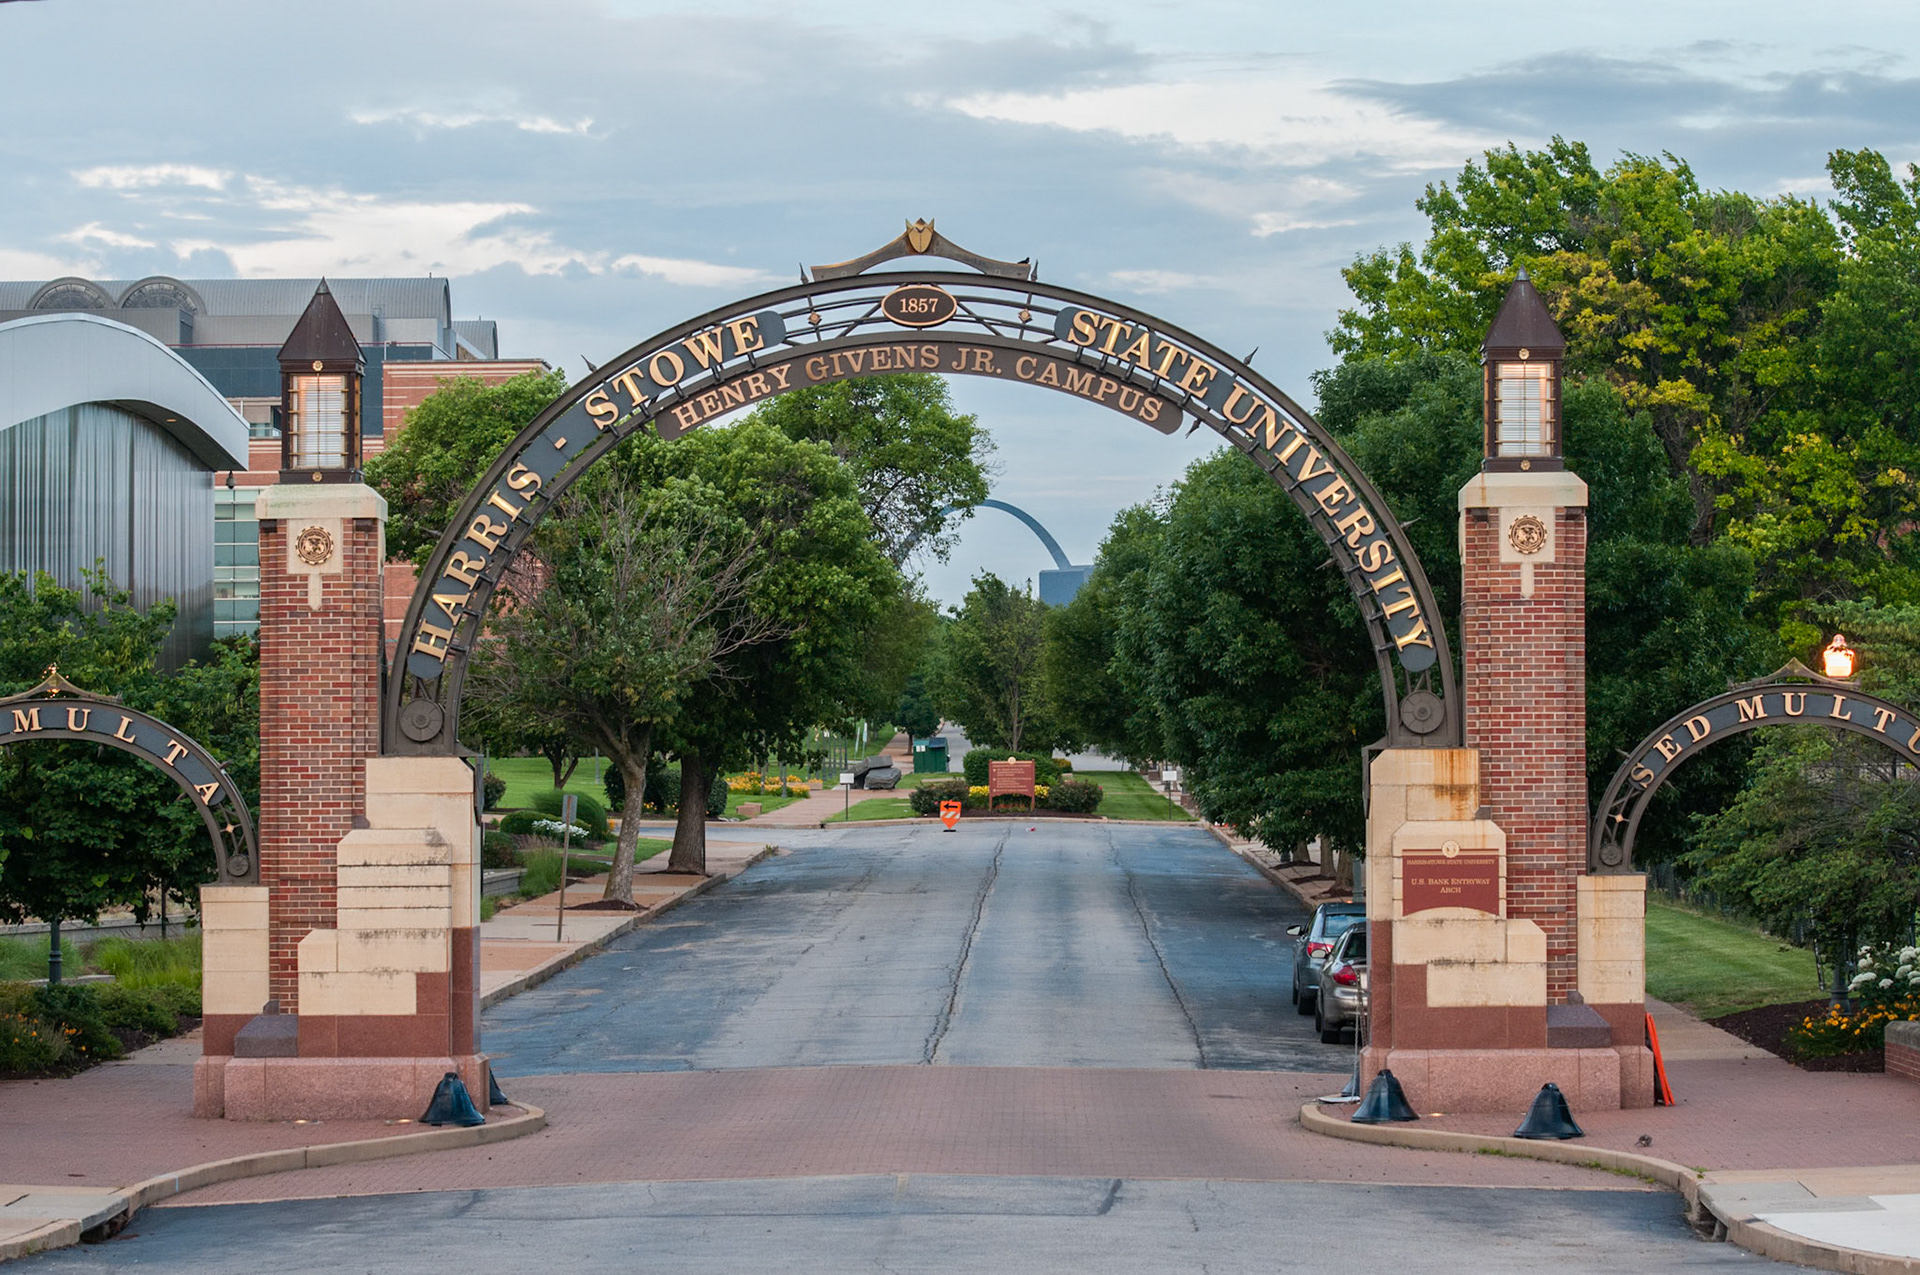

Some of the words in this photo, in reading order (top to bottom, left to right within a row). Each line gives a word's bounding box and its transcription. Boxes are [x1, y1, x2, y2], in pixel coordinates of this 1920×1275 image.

[900, 297, 938, 314] 1857
[671, 363, 792, 431] HENRY
[805, 345, 940, 382] GIVENS
[951, 347, 1003, 374] JR.
[1015, 356, 1163, 422] CAMPUS
[413, 461, 542, 663] HARRIS
[585, 314, 765, 431] STOWE
[1067, 310, 1217, 398] STATE
[1220, 382, 1432, 653] UNIVERSITY
[11, 707, 220, 805] MULTA
[1630, 715, 1711, 788] SED
